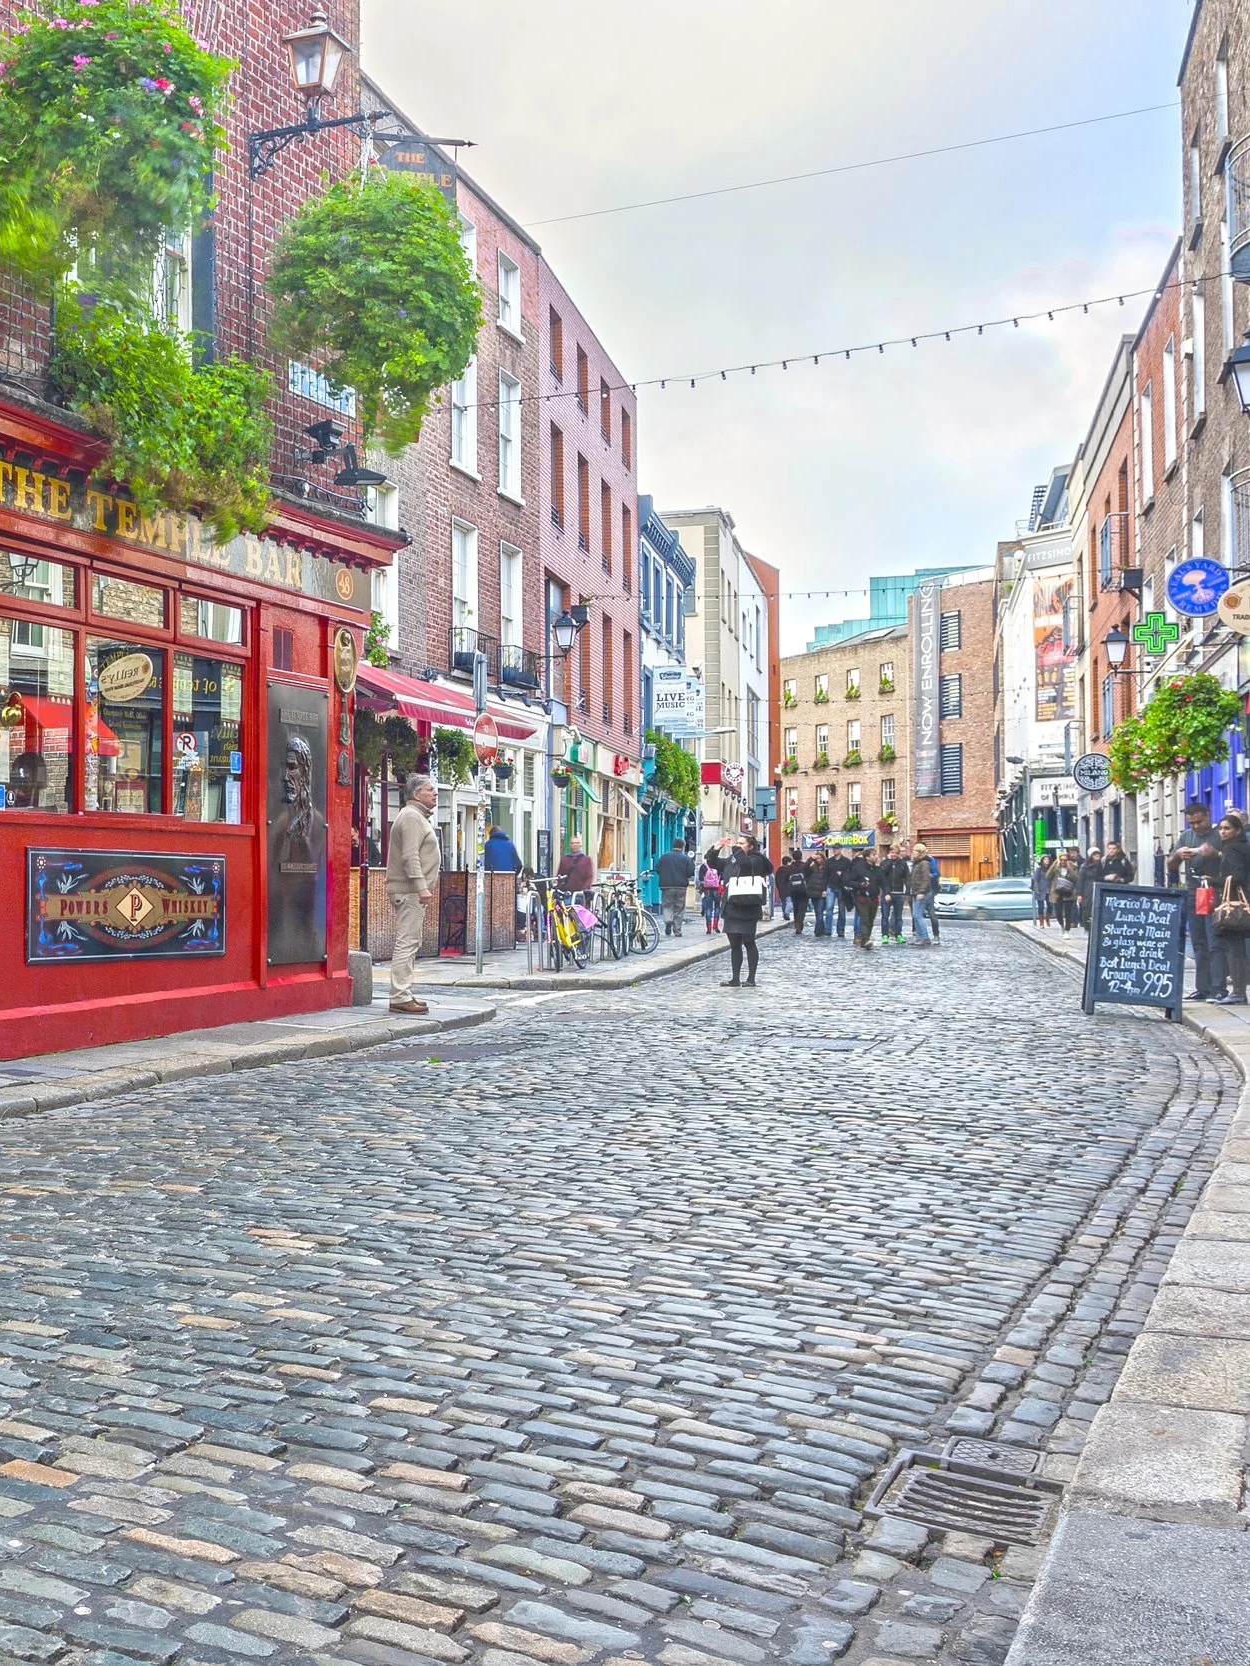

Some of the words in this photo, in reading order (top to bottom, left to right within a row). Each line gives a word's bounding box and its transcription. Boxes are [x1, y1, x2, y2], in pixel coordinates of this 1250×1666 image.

[395, 151, 426, 164] THE
[244, 537, 301, 588] BAR
[1195, 561, 1223, 576] YARD
[338, 575, 351, 595] 48
[920, 582, 935, 691] ENROLLING
[656, 693, 686, 702] LIVE
[656, 701, 686, 709] MUSIC
[921, 698, 934, 745] NOW
[60, 899, 108, 917] POWERS
[129, 893, 143, 923] P
[162, 898, 208, 915] WHISKEY
[1105, 896, 1140, 911] Mexico
[1152, 898, 1177, 913] Rome
[1114, 911, 1146, 924] Lunch
[1147, 911, 1171, 925] Deal
[1102, 924, 1137, 936] Starter
[1145, 925, 1171, 939] Main
[1113, 936, 1135, 949] glass
[1136, 938, 1156, 948] wine
[1119, 946, 1136, 958] soft
[1139, 947, 1166, 960] drink
[1099, 956, 1119, 968] Best
[1119, 957, 1147, 970] Lunch
[1148, 959, 1170, 972] Deal
[1100, 968, 1137, 982] Around
